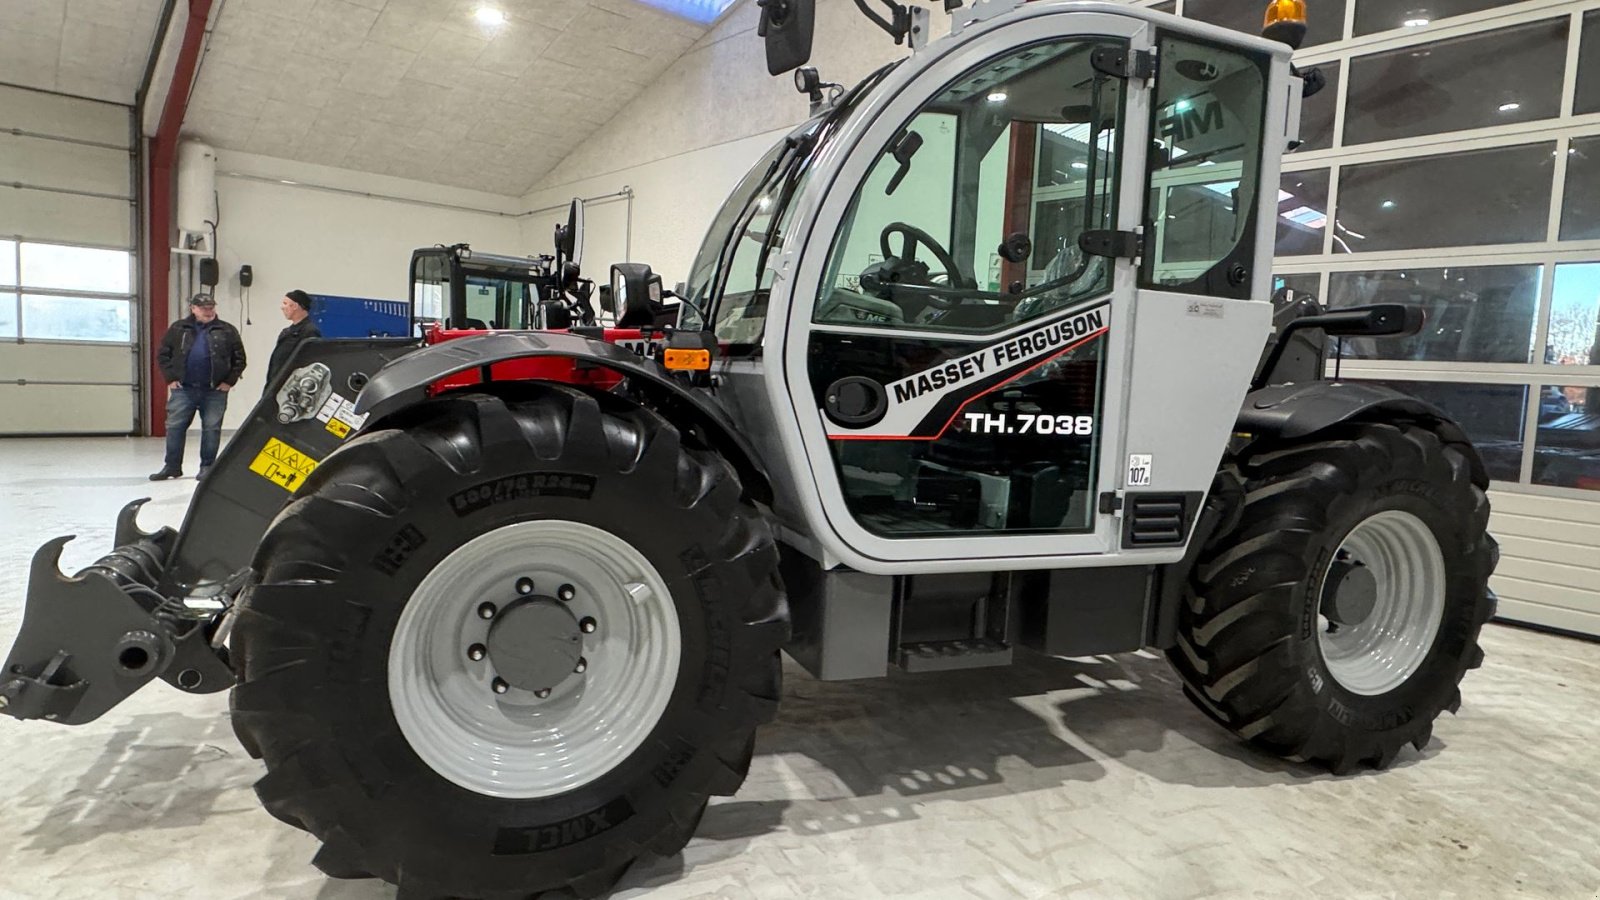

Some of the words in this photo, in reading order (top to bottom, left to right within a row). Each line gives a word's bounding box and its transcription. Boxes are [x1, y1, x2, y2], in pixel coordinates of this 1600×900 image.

[893, 352, 986, 404] MASSEY
[993, 310, 1103, 367] FERGUSON
[965, 413, 1093, 435] TH.7038
[1130, 467, 1145, 483] 107
